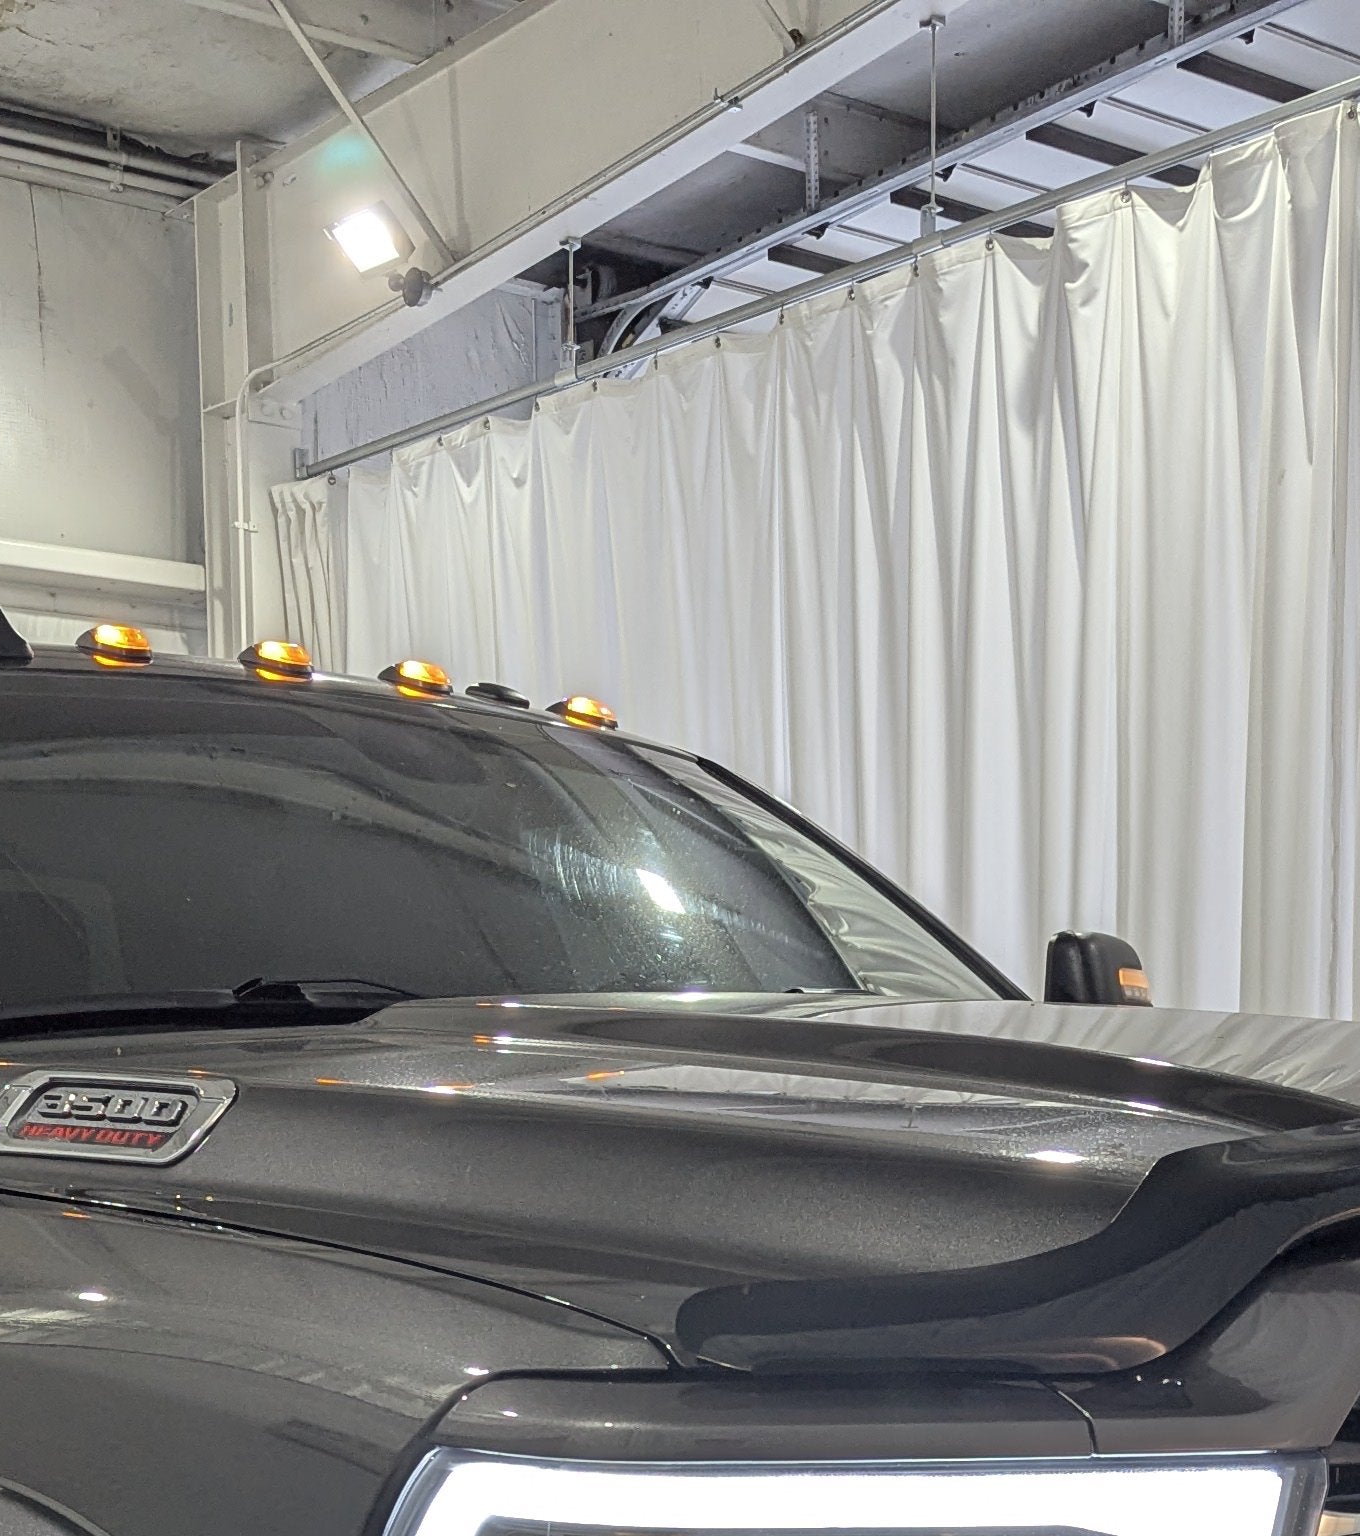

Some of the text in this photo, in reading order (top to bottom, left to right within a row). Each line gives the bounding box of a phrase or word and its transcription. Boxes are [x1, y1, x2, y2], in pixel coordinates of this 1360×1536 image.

[38, 1090, 189, 1127] 3500
[19, 1124, 162, 1146] HEAVY DUTY
